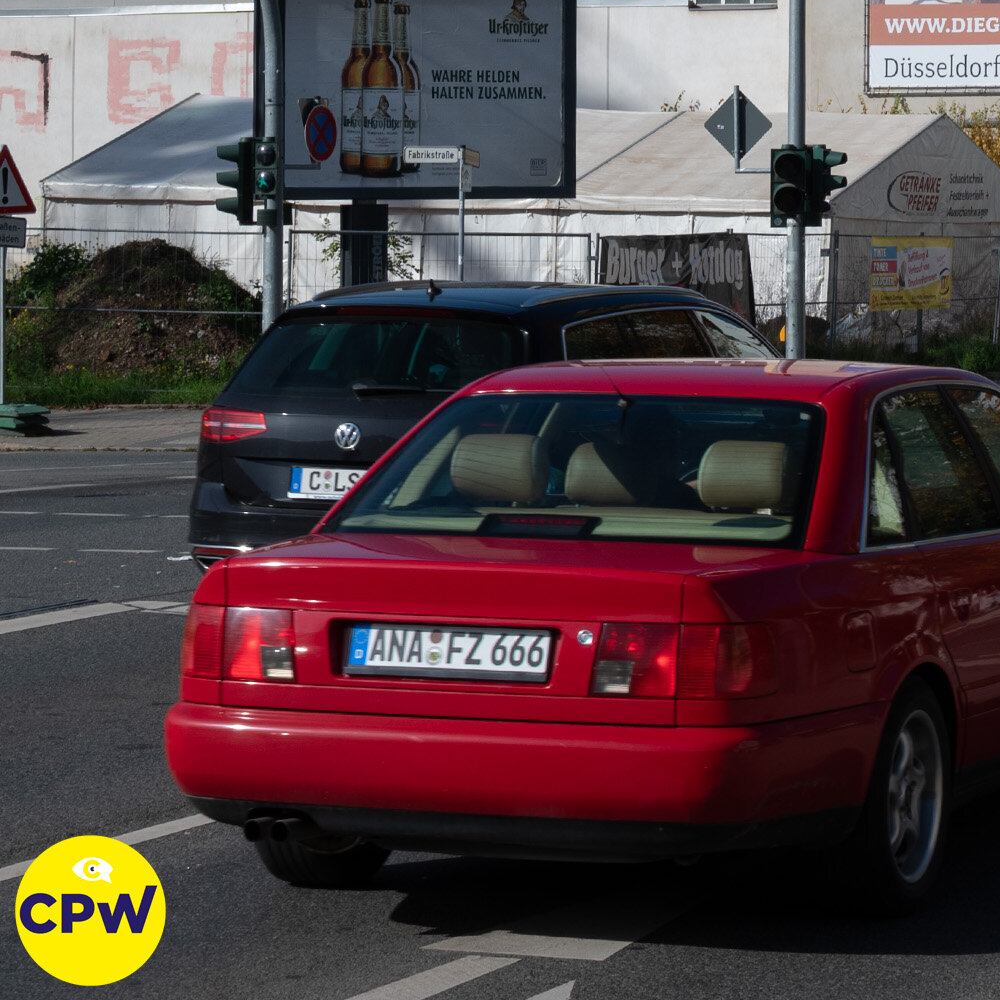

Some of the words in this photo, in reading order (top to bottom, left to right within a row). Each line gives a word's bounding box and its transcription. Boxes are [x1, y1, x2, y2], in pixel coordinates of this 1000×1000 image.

[431, 69, 472, 83] WAHRE
[477, 70, 520, 83] HELDEN
[431, 86, 474, 100] HALTEN
[478, 86, 547, 100] ZUSAMMEN.
[408, 150, 455, 160] Fabrikstraße
[907, 194, 939, 212] PFEIFER
[605, 239, 666, 286] Burger
[689, 240, 743, 291] Hotdog
[309, 470, 321, 491] C
[369, 628, 423, 663] ANA
[446, 631, 484, 665] FZ
[491, 632, 545, 668] 666
